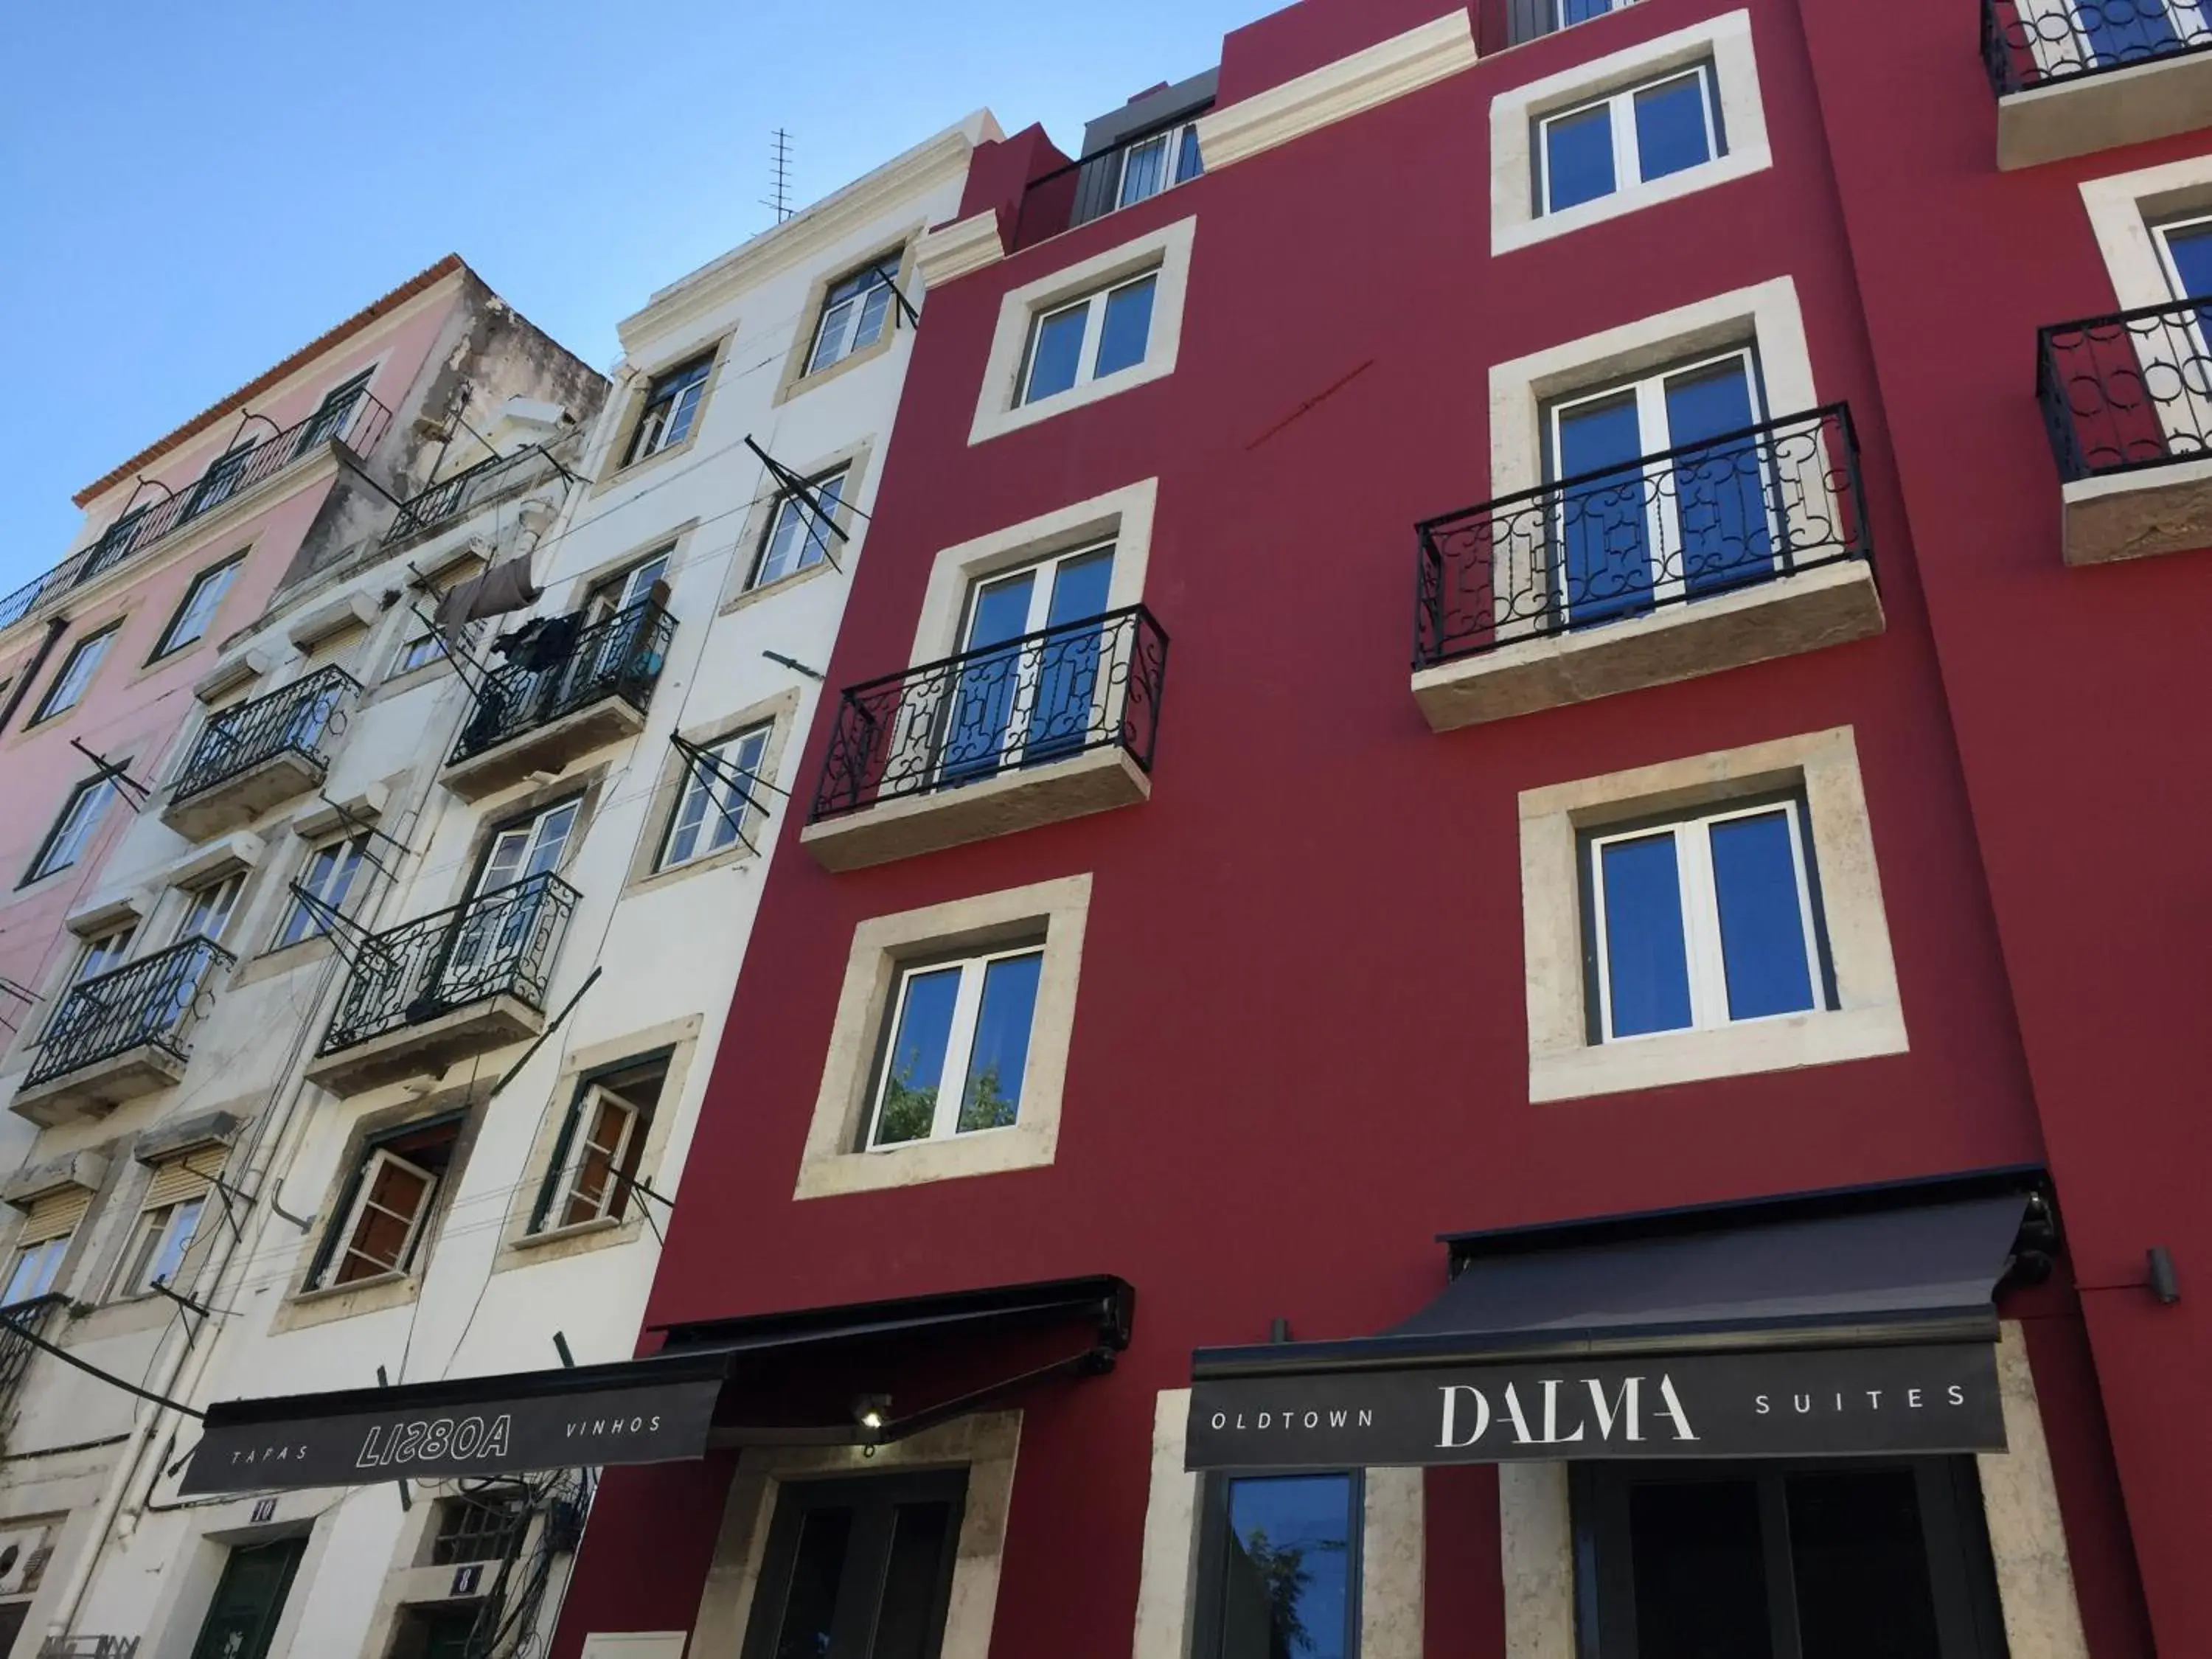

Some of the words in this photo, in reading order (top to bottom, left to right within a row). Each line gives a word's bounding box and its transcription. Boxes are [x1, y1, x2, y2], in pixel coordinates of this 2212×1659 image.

[232, 1445, 307, 1464] TAPAS
[566, 1416, 661, 1438] VINHOS
[1211, 1409, 1373, 1430] OLDTOWN
[1434, 1373, 1701, 1447] DALMA
[1755, 1385, 1964, 1413] SUITES
